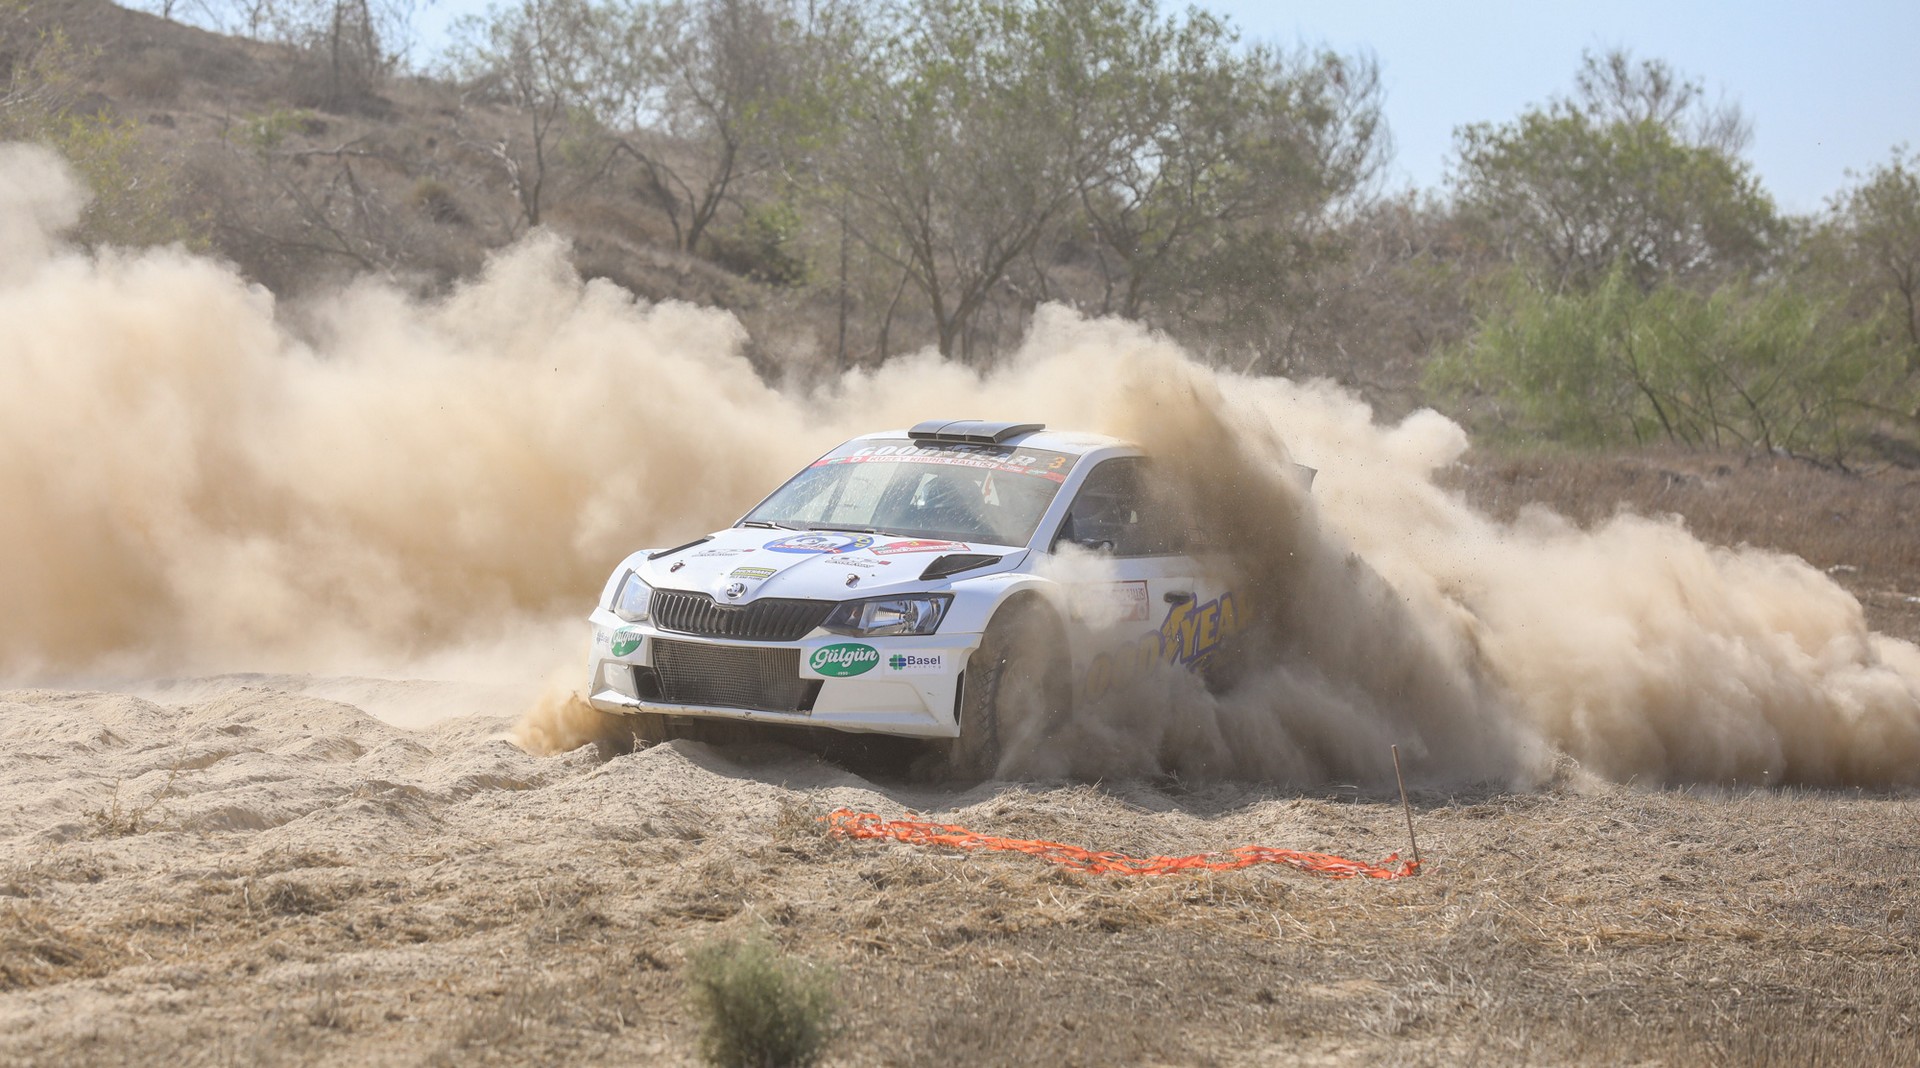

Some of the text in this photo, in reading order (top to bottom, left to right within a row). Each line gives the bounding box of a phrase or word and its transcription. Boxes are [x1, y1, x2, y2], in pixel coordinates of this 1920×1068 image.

[1048, 456, 1066, 469] 3
[812, 647, 878, 669] Gülgün
[907, 655, 941, 665] Basel
